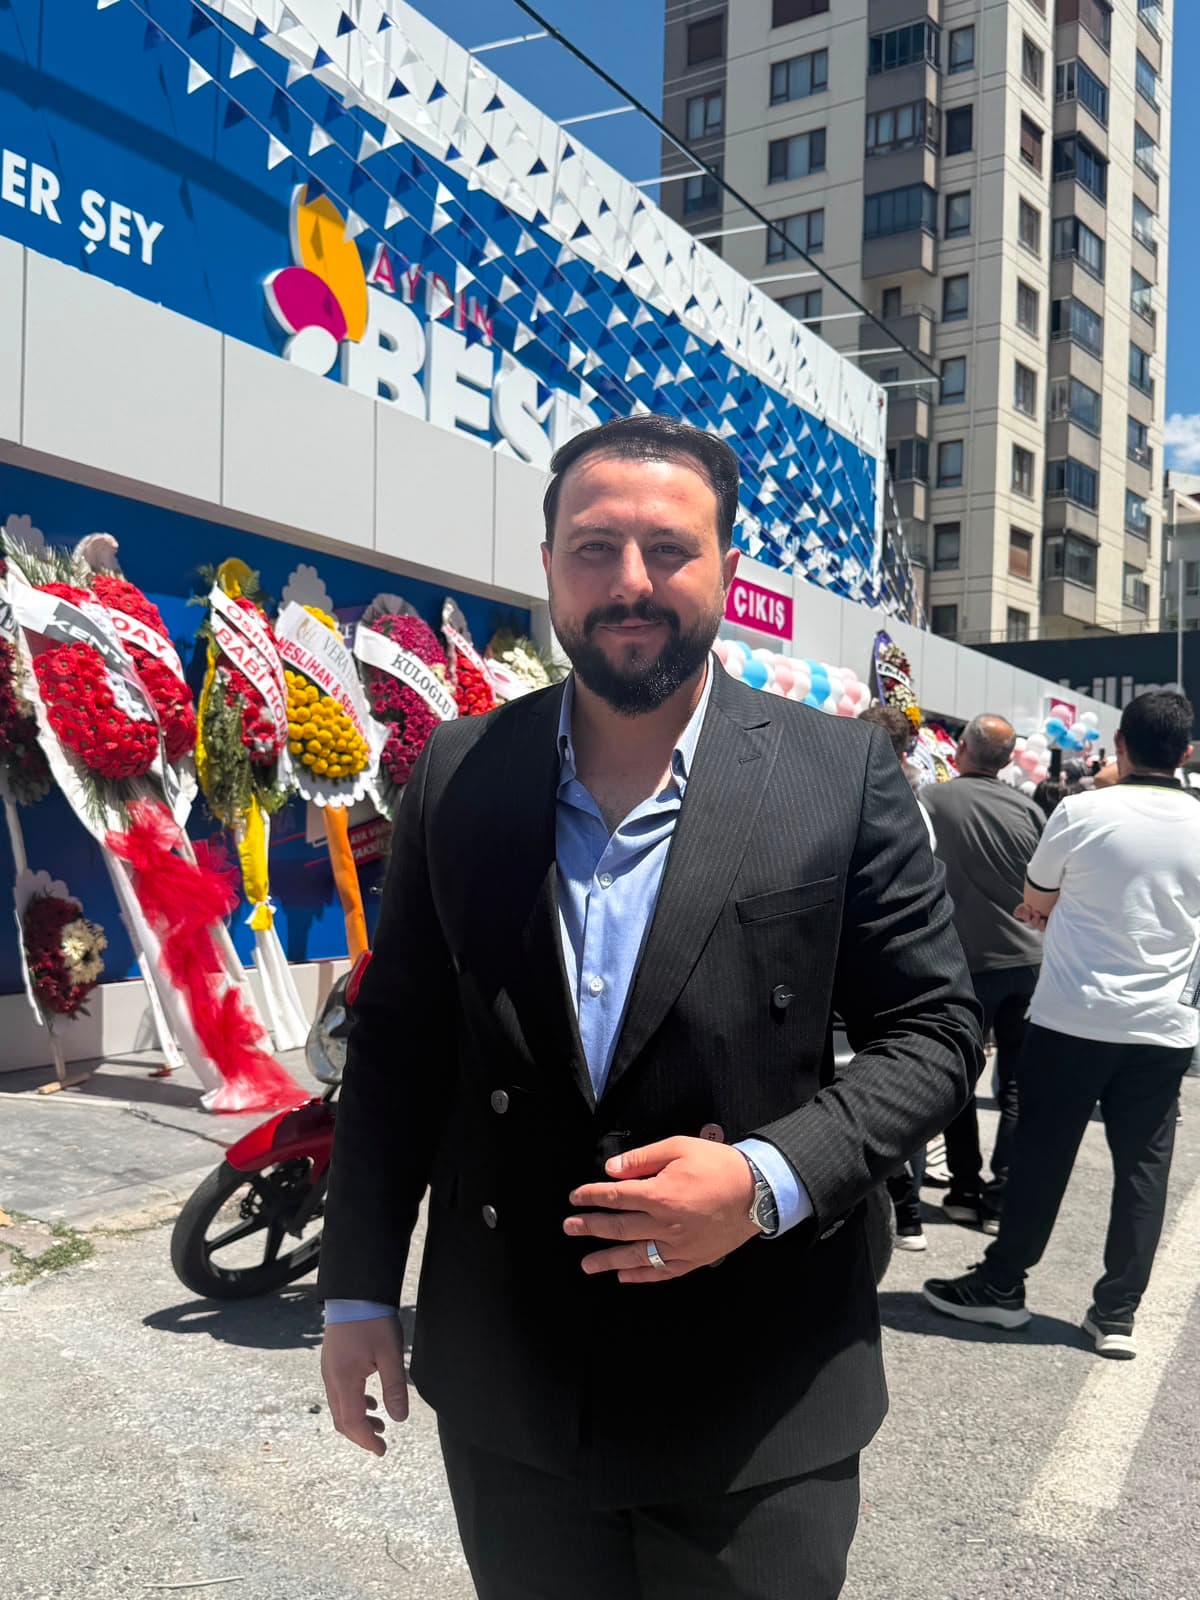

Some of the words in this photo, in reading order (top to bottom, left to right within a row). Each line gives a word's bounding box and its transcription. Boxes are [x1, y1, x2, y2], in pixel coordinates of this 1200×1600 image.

[79, 189, 165, 265] ŞEY
[366, 242, 494, 346] AYDIN
[734, 586, 786, 631] ÇIKIŞ
[51, 617, 122, 663] KENT
[277, 637, 334, 688] NESLİHAN
[390, 654, 451, 715] KULOĞLU
